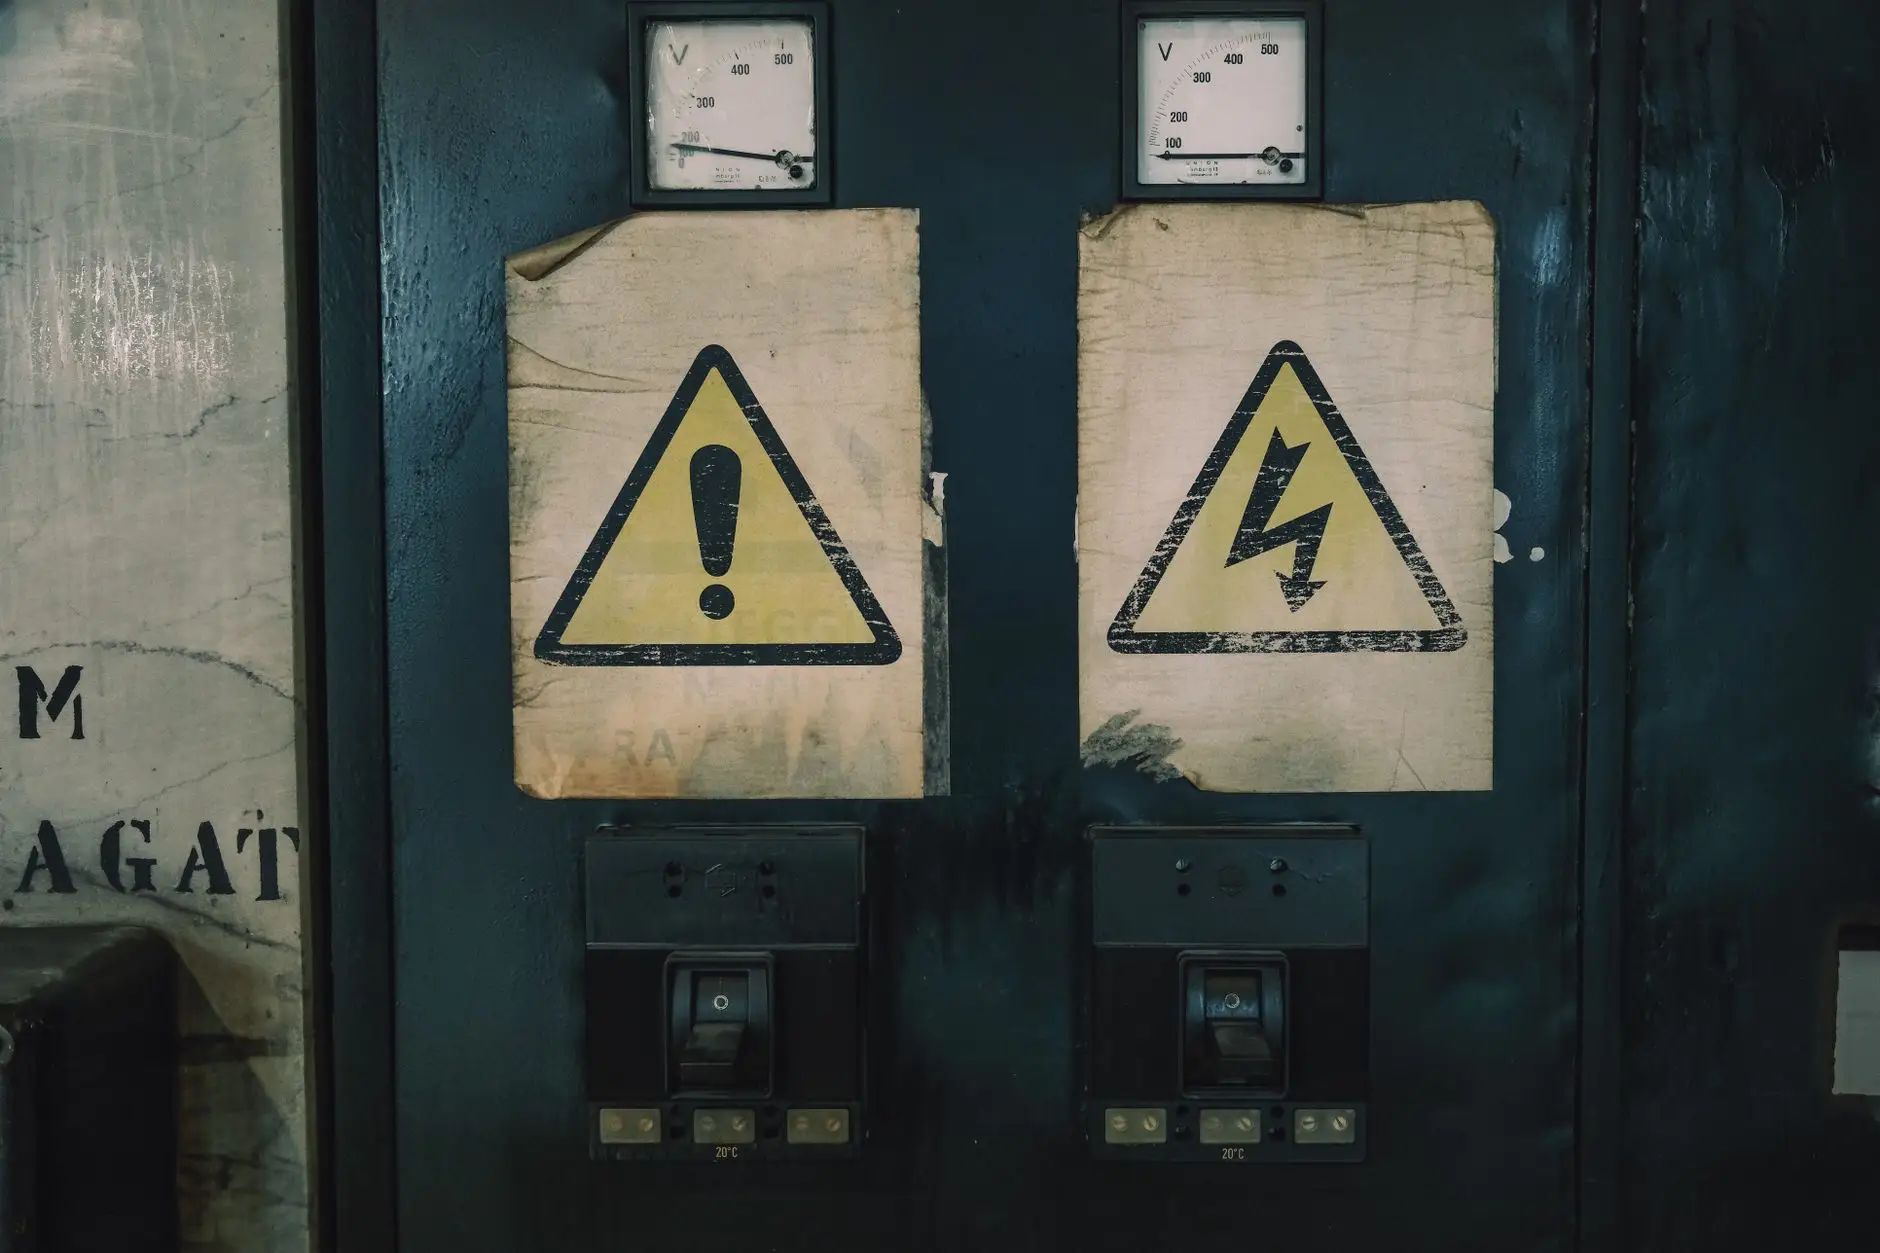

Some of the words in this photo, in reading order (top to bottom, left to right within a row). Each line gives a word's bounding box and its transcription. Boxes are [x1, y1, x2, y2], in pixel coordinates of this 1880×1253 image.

[668, 44, 689, 66] V
[1158, 42, 1173, 62] V
[1260, 44, 1279, 55] 500
[774, 53, 793, 65] 500
[1223, 53, 1243, 65] 400
[730, 63, 750, 75] 400
[1193, 72, 1211, 83] 300
[696, 96, 715, 108] 300
[1170, 111, 1188, 123] 200
[681, 131, 700, 143] 200
[1165, 137, 1182, 149] 100
[15, 665, 86, 740] M
[14, 820, 300, 902] AGAT
[715, 1146, 739, 1159] 20°C
[1221, 1147, 1245, 1160] 20°C
